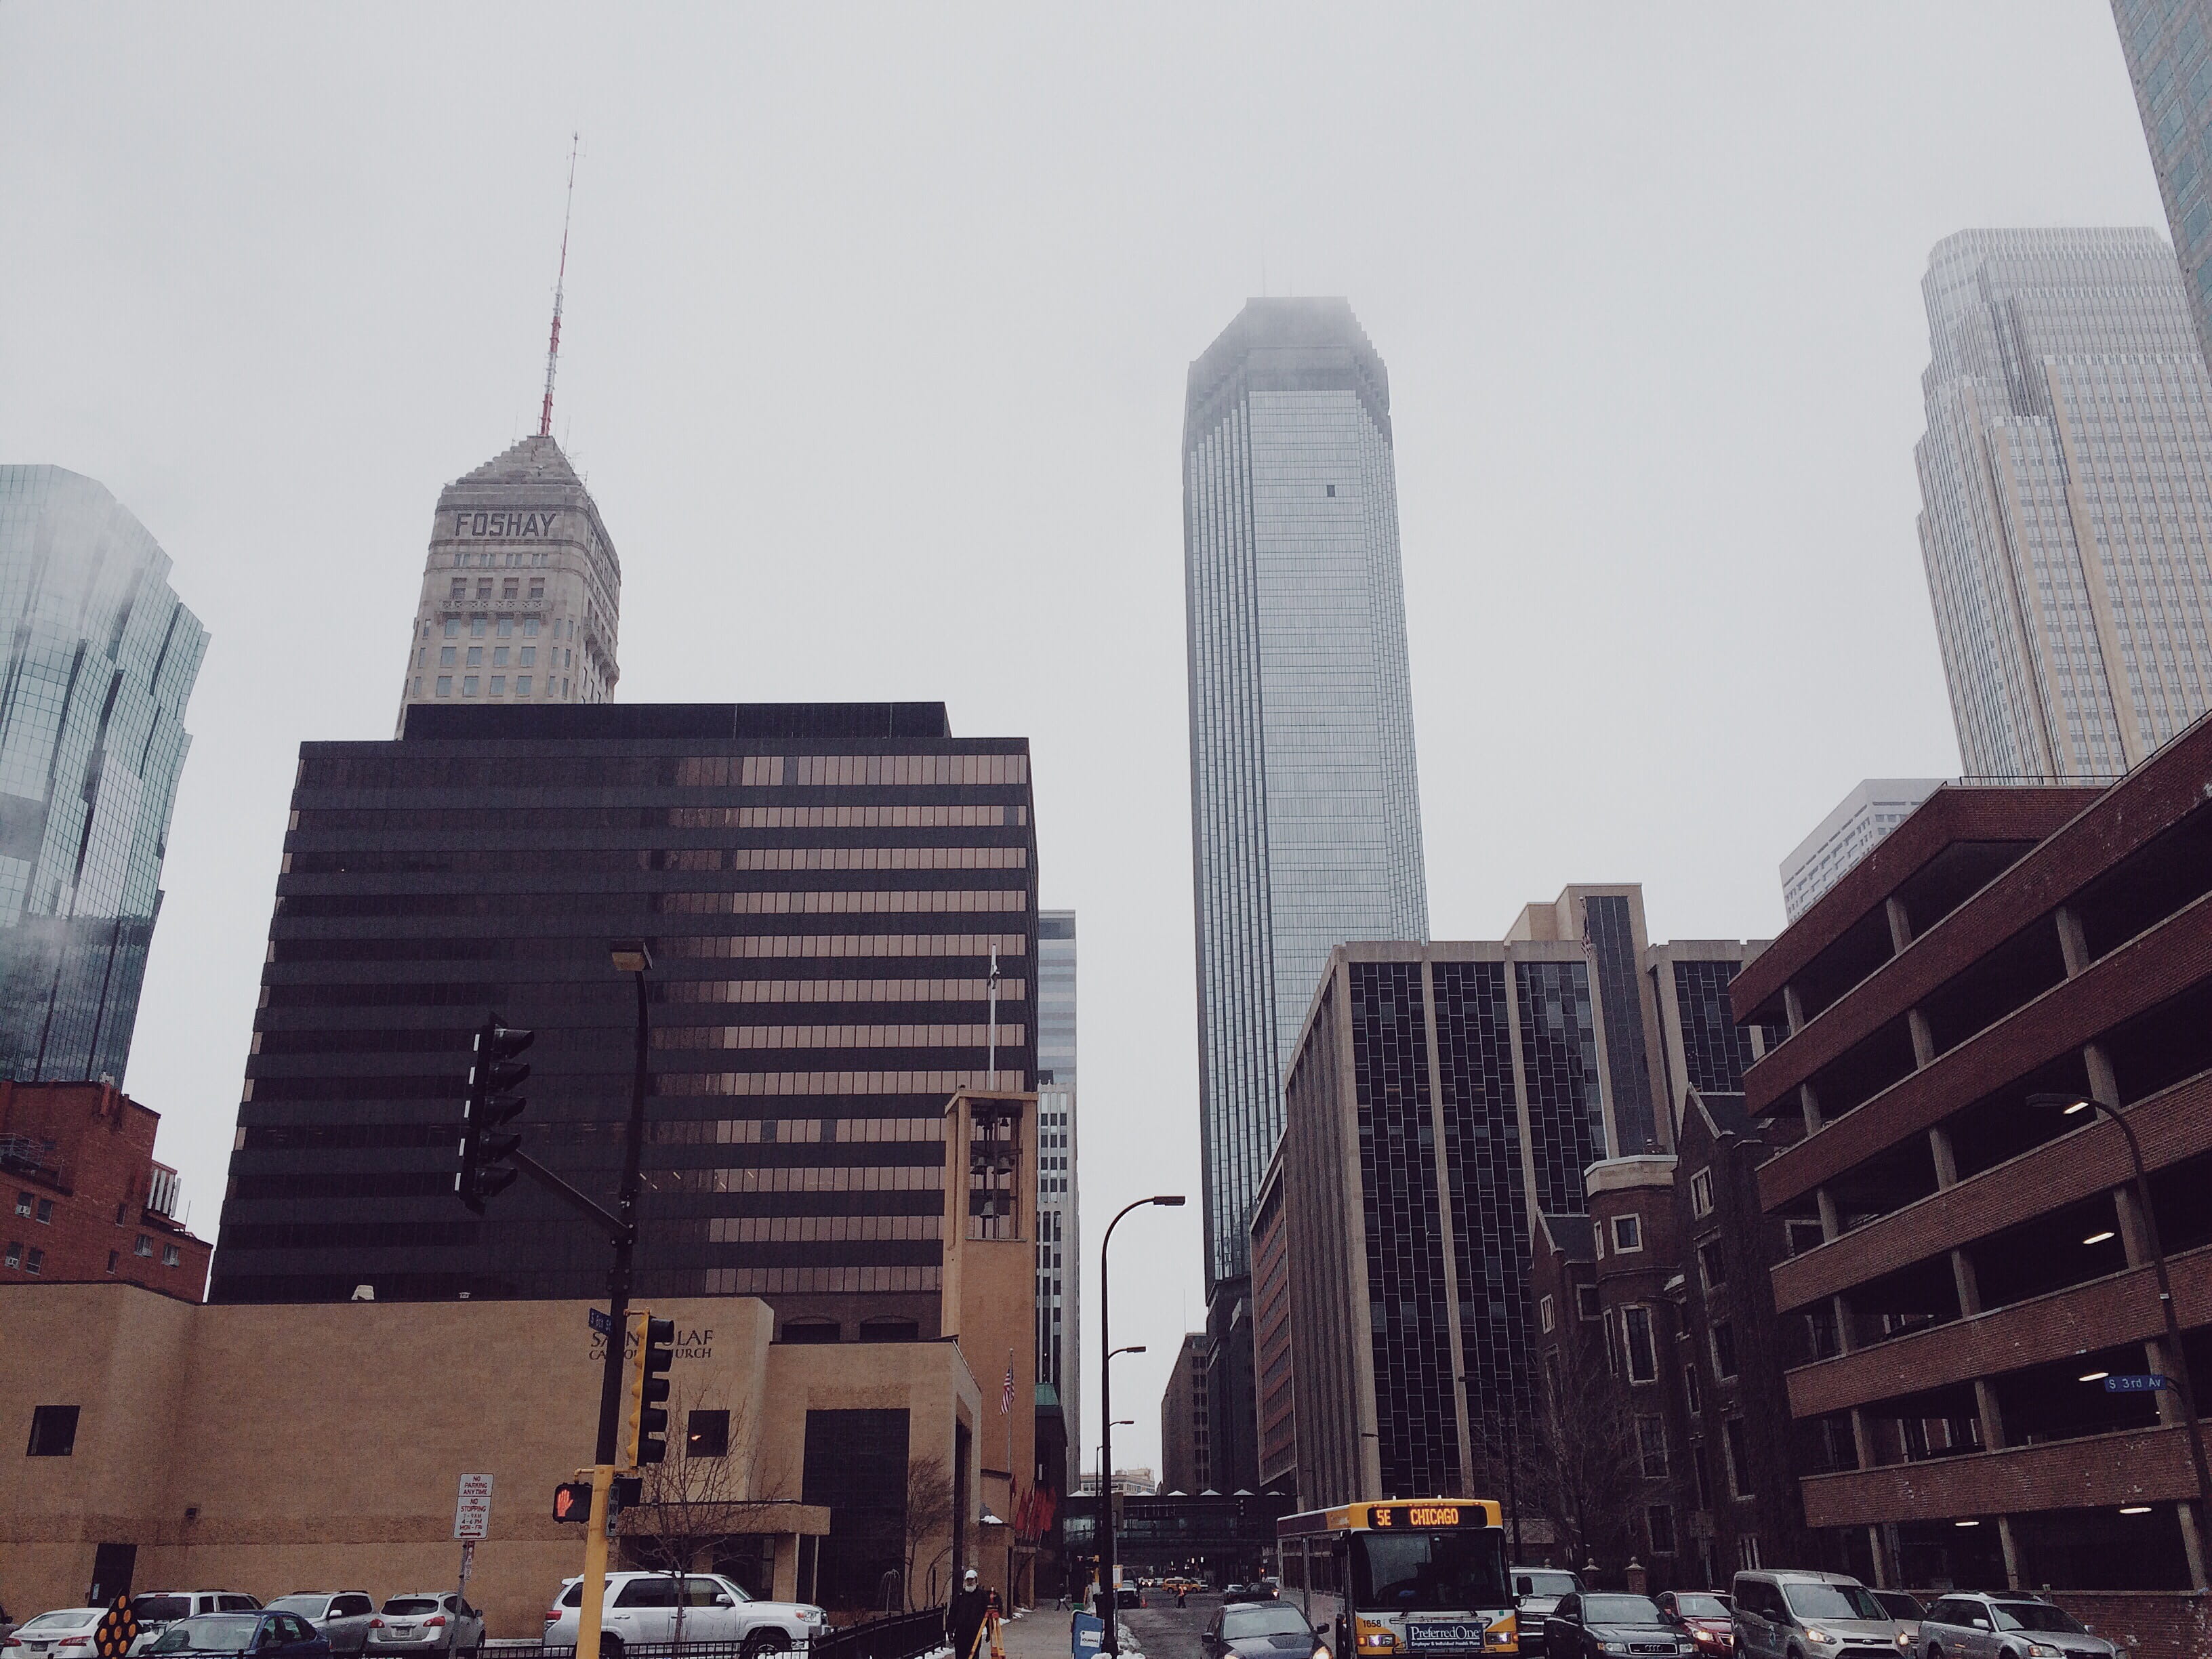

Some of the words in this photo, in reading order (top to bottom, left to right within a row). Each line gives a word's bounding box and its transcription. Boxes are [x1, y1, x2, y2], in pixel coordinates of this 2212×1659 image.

[455, 513, 556, 537] FOSHAY
[662, 1330, 713, 1346] LAF
[675, 1348, 712, 1358] URCH
[2109, 1379, 2116, 1389] S
[2122, 1378, 2142, 1388] 3rd
[2149, 1378, 2160, 1387] Av
[1376, 1510, 1391, 1526] 5E
[1410, 1508, 1458, 1525] CHICAGO
[1410, 1626, 1480, 1640] PreferredOne
